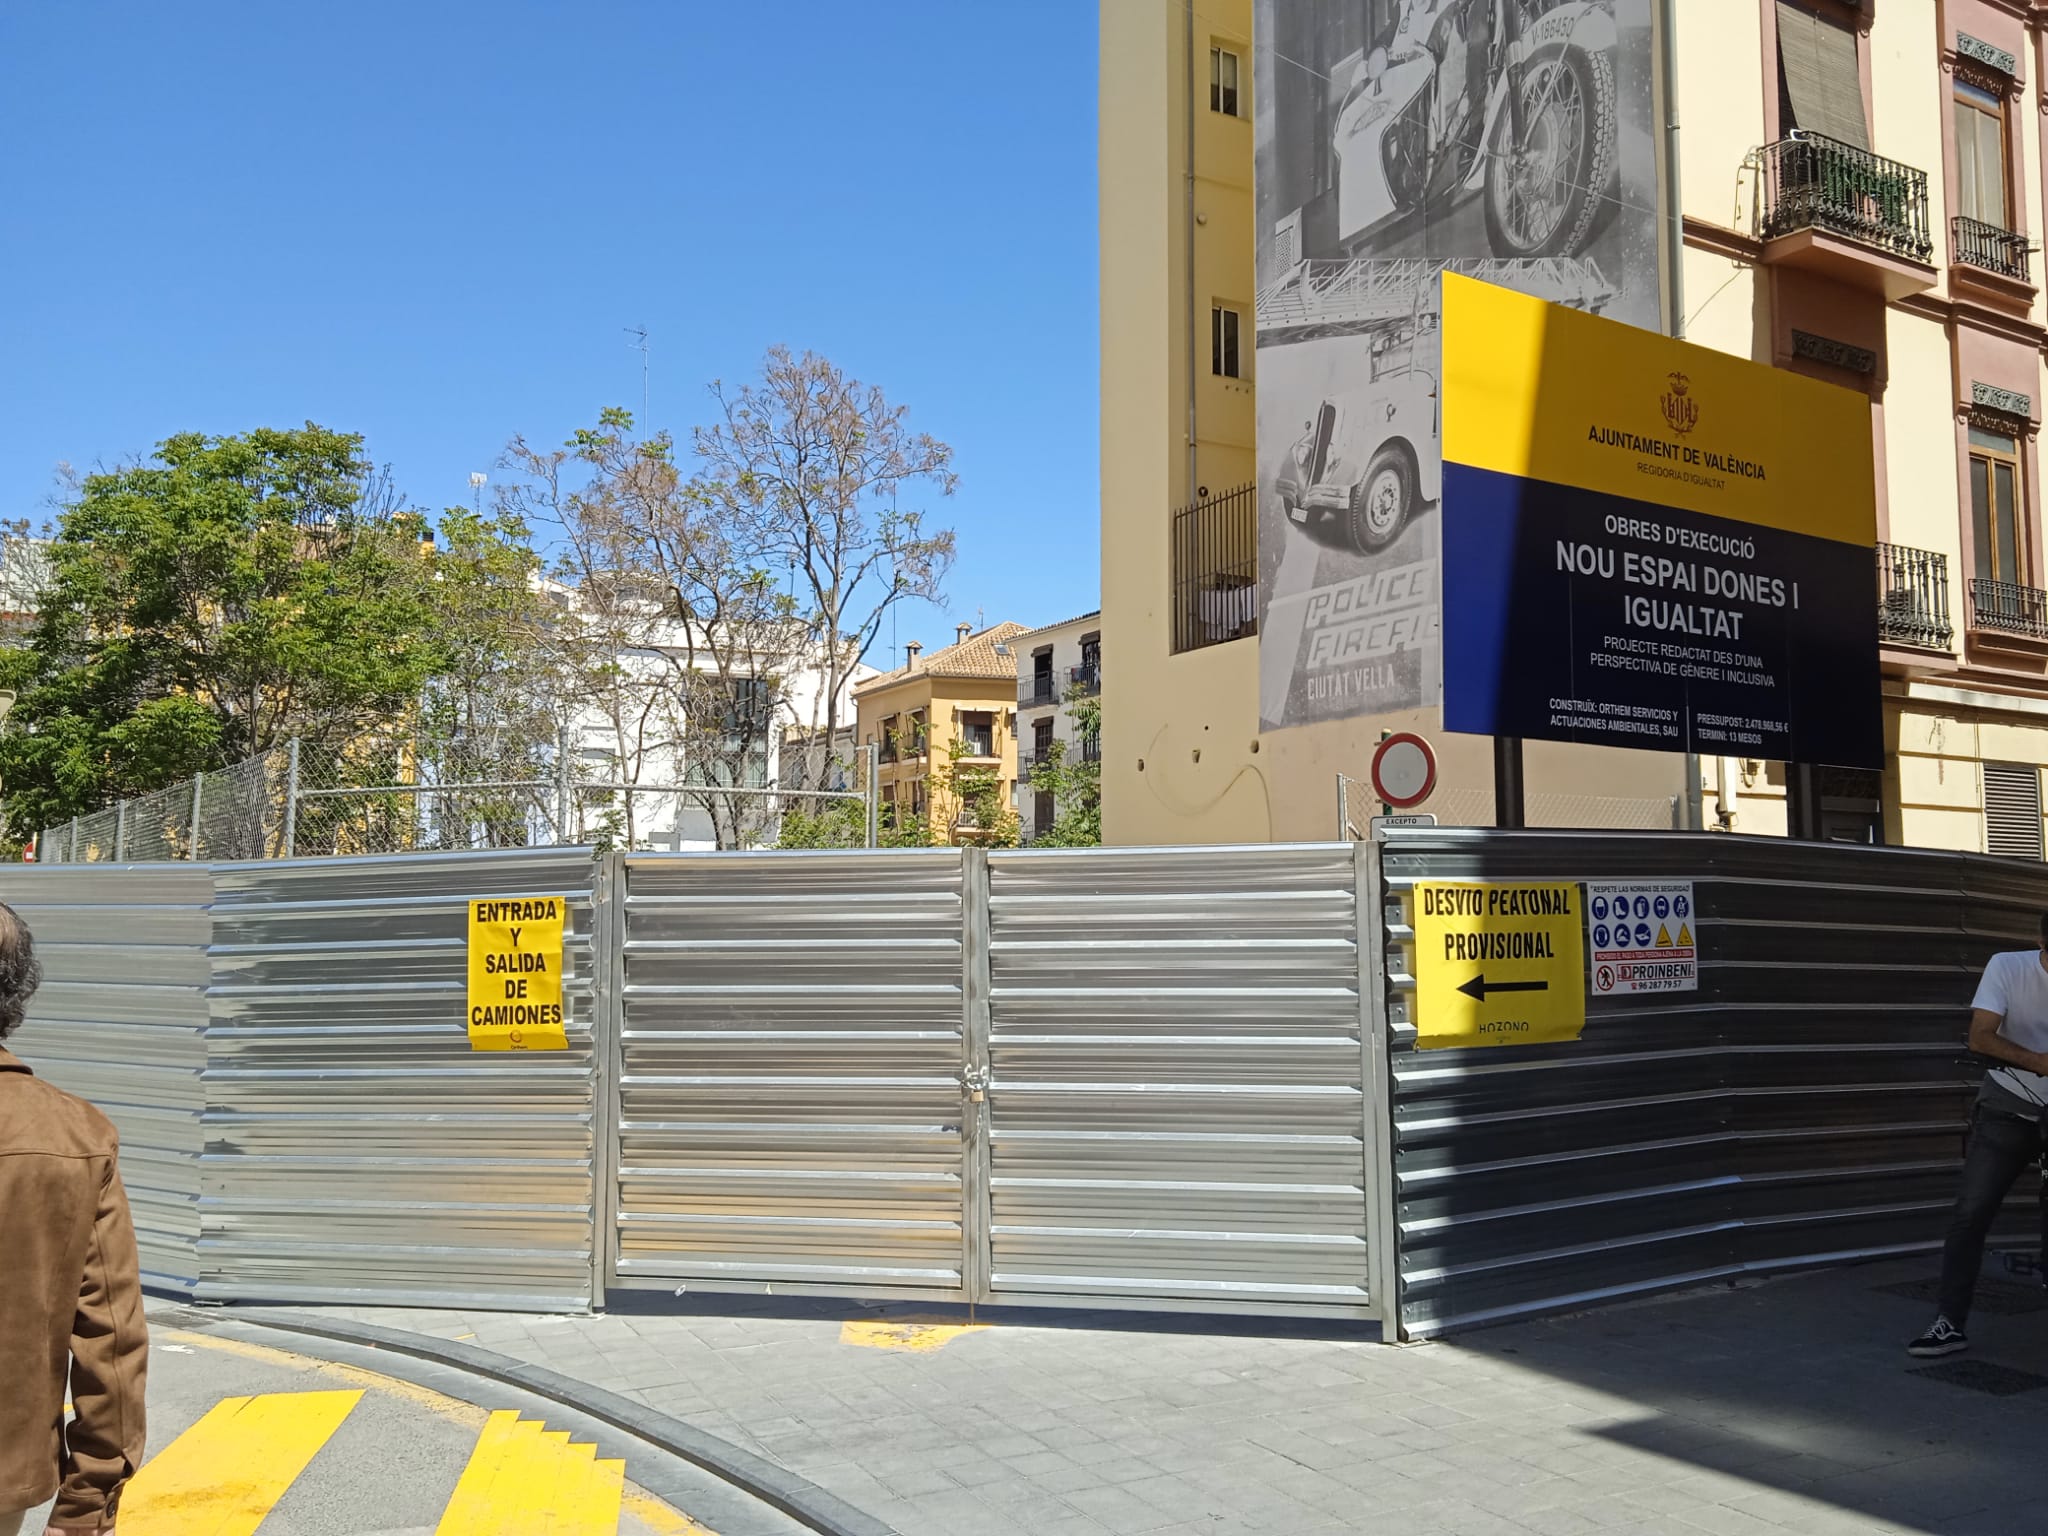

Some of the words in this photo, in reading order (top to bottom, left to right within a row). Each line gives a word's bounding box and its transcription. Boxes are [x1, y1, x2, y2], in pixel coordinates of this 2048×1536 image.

[1588, 425, 1680, 461] AJUNTAMENT
[1683, 447, 1700, 465] DE
[1703, 452, 1766, 481] VALÈNCIA
[1637, 462, 1681, 481] REGIDORIA
[1605, 515, 1661, 542] OBRES
[1666, 527, 1755, 560] D'EXECUCIÓ
[1556, 540, 1615, 579] NOU
[1624, 552, 1697, 592] ESPAI
[1703, 566, 1786, 607] DONES
[1792, 582, 1799, 609] I
[1624, 595, 1744, 640] IGUALTAT
[1604, 636, 1659, 655] PROJECTE
[1660, 643, 1712, 662] REDACTAT
[1713, 651, 1733, 665] DES
[1735, 654, 1763, 669] D'UNA
[1590, 653, 1662, 674] PERSPECTIVA
[1663, 662, 1678, 676] DE
[1721, 669, 1725, 681] I
[1727, 670, 1775, 688] INCLUSIVA
[1307, 671, 1350, 700] CIUTAT
[1354, 664, 1395, 692] VELLA
[1599, 703, 1631, 717] ORTHEM
[1632, 706, 1672, 721] SERVICIOS
[1672, 711, 1679, 721] Y
[1697, 713, 1744, 728] PRESSUPOST:
[1550, 715, 1607, 731] ACTUACIONES
[1608, 720, 1662, 736] AMBIENTALES,
[1663, 725, 1678, 737] SAU
[1697, 728, 1727, 741] TERMINI:
[1738, 732, 1762, 744] MESOS
[477, 900, 556, 922] ENTRADA
[1424, 888, 1483, 916] DESVIO
[1488, 889, 1570, 916] PEATONAL
[510, 927, 522, 947] Y
[1445, 932, 1555, 960] PROVISIONAL
[485, 953, 546, 974] SALIDA
[1632, 963, 1691, 979] PROINBENI
[505, 979, 527, 999] DE
[1638, 982, 1647, 990] 96
[1648, 981, 1662, 990] 287
[472, 1004, 561, 1025] CAMIONES
